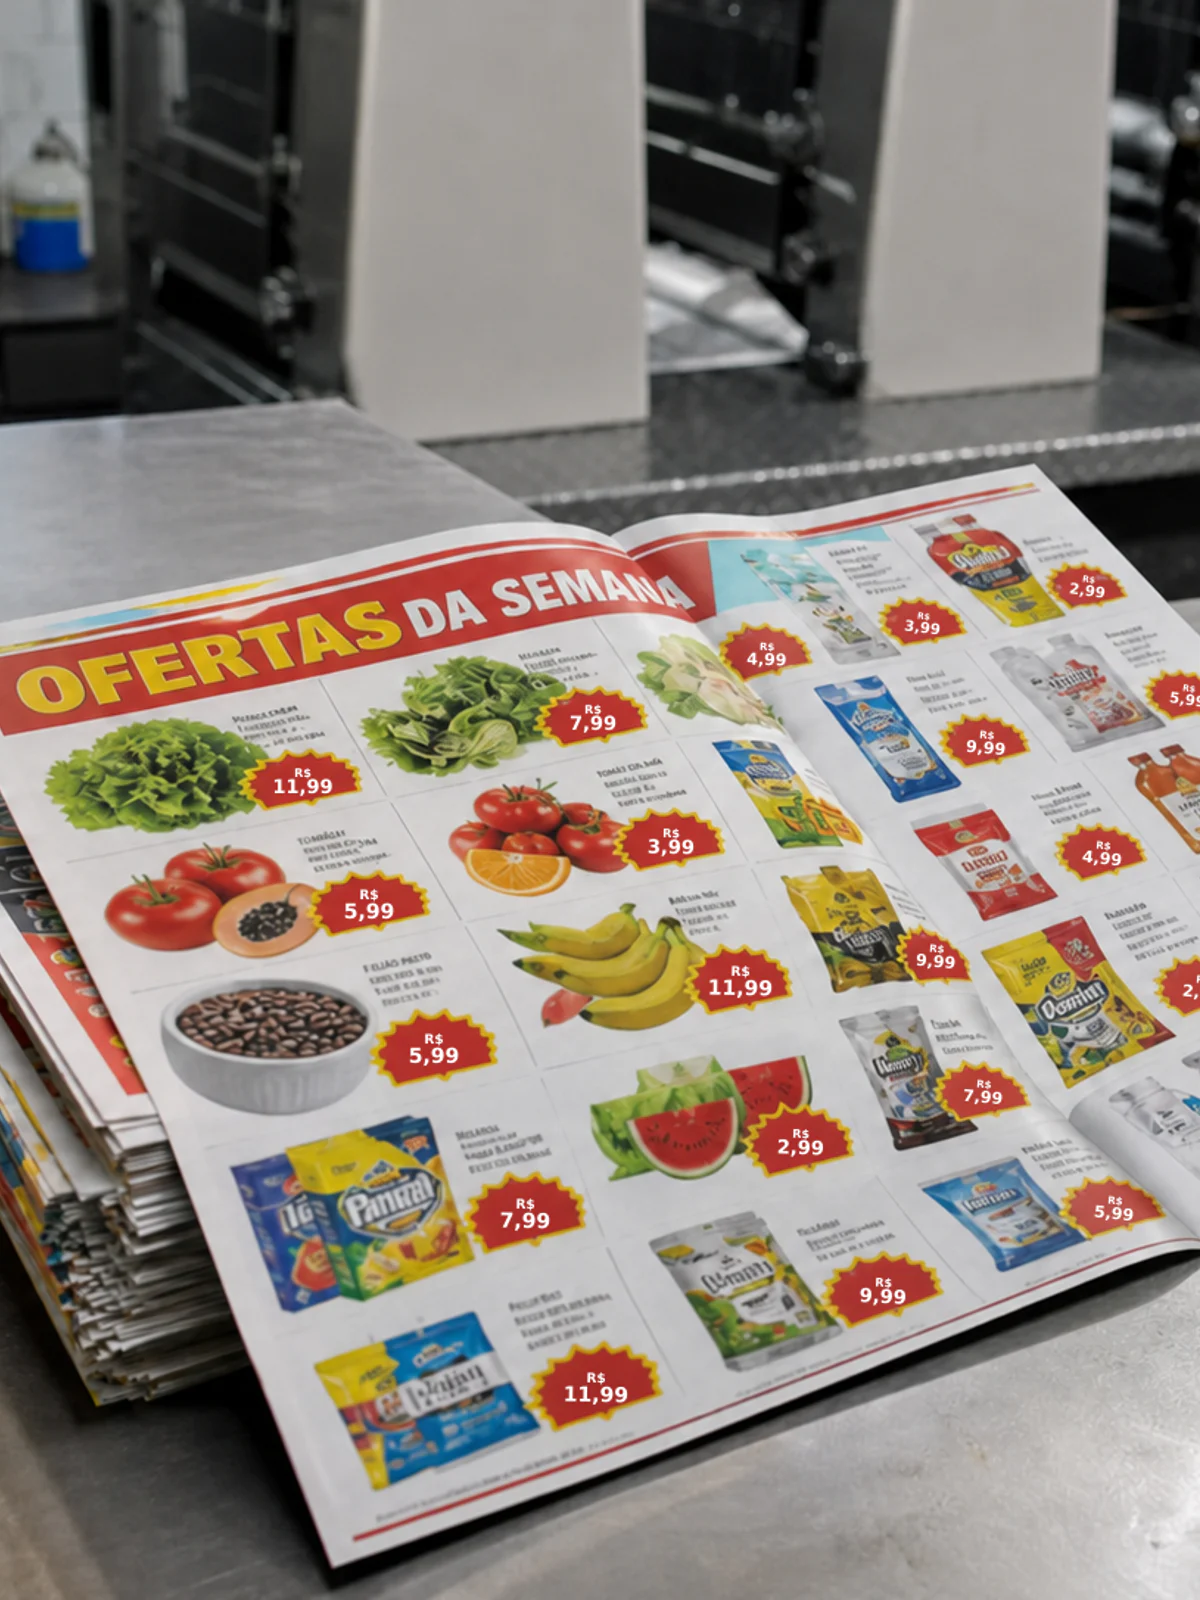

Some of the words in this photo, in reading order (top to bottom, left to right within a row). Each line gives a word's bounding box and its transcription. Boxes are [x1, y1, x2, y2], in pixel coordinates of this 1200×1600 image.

[1082, 574, 1095, 585] R$
[1069, 581, 1106, 599] 2,99
[917, 611, 930, 621] R$
[904, 618, 941, 635] 3,99
[16, 600, 402, 714] OFERTAS
[402, 589, 488, 639] DA
[491, 569, 697, 618] SEMANA
[759, 641, 775, 653] R$
[746, 651, 787, 668] 4,99
[1182, 683, 1196, 694] R$
[584, 704, 602, 716] R$
[570, 714, 616, 734] 7,99
[979, 729, 995, 741] R$
[966, 739, 1006, 756] 9,99
[294, 767, 312, 779] R$
[274, 778, 333, 797] 11,99
[663, 827, 680, 839] R$
[647, 838, 695, 857] 3,99
[1096, 840, 1111, 851] R$
[1081, 849, 1122, 867] 4,99
[359, 888, 379, 902] R$
[344, 902, 394, 922] 5,99
[929, 943, 945, 954] R$
[916, 953, 956, 970] 9,99
[731, 965, 750, 979] R$
[709, 978, 773, 999] 11,99
[424, 1032, 444, 1046] R$
[409, 1046, 459, 1067] 5,99
[976, 1079, 992, 1090] R$
[963, 1088, 1003, 1105] 7,99
[792, 1128, 810, 1140] R$
[777, 1138, 824, 1158] 2,99
[515, 1197, 535, 1212] R$
[1107, 1195, 1123, 1207] R$
[1093, 1204, 1134, 1222] 5,99
[500, 1211, 550, 1232] 7,99
[875, 1277, 892, 1289] R$
[859, 1287, 907, 1306] 9,99
[586, 1371, 606, 1385] R$
[564, 1385, 628, 1406] 11,99
